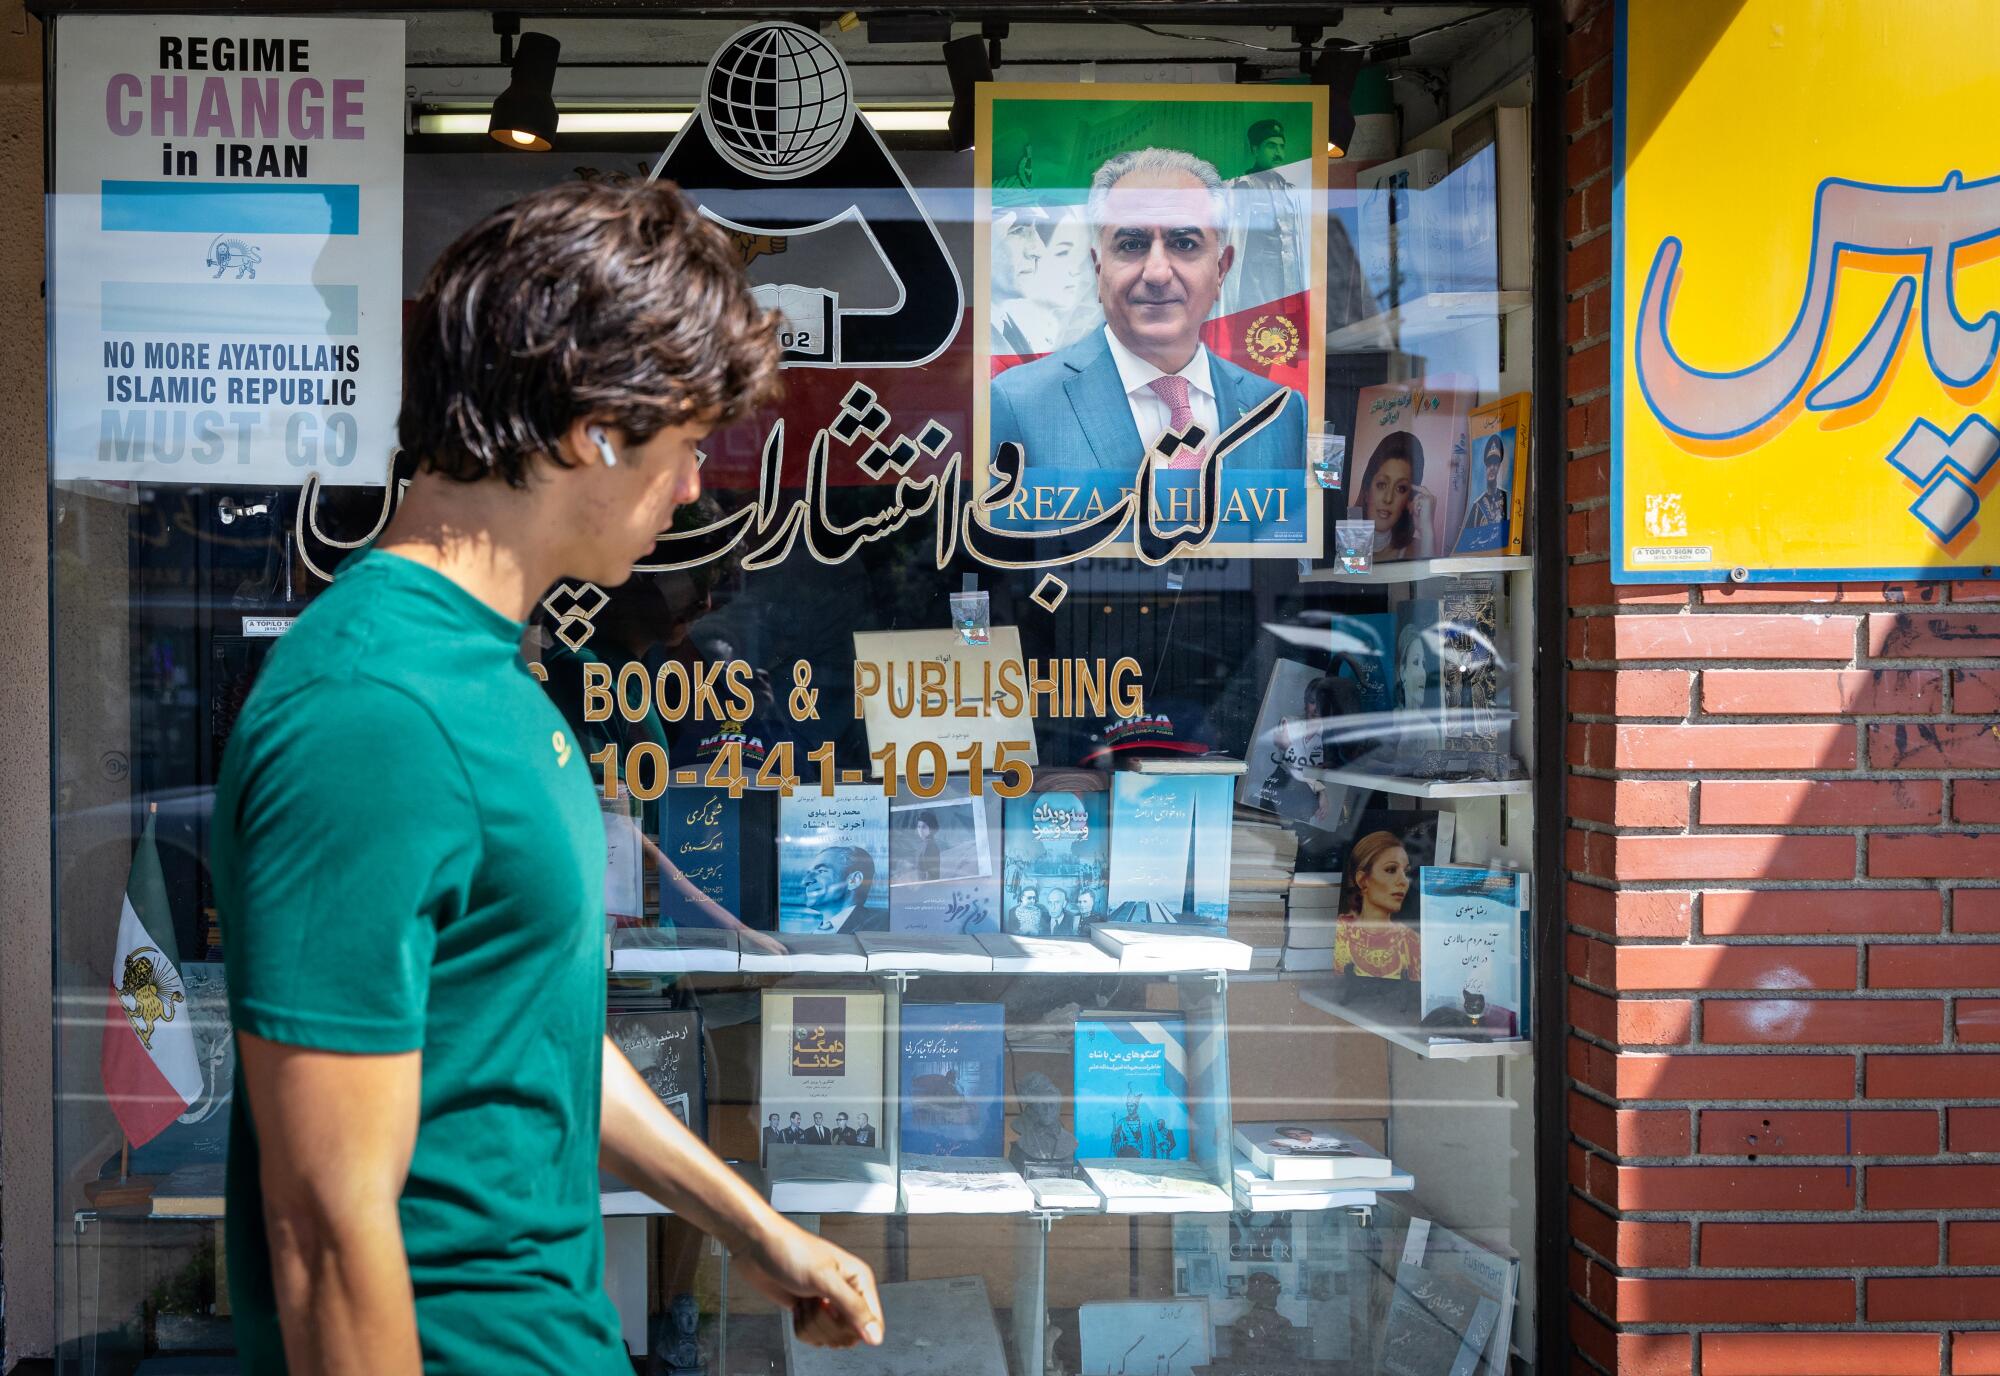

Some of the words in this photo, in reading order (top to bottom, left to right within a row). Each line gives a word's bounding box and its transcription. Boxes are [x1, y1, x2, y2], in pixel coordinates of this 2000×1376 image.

[159, 36, 310, 73] REGIME
[105, 73, 366, 140] CHANGE
[162, 143, 198, 176] in
[215, 144, 308, 178] IRAN
[103, 341, 135, 369] NO
[144, 342, 210, 371] MORE
[218, 343, 360, 372] AYATOLLAHS
[107, 375, 216, 404] ISLAMIC
[228, 377, 357, 406] REPUBLIC
[98, 409, 261, 466] MUST
[285, 411, 358, 467] GO
[1007, 486, 1105, 521] REZA
[1118, 487, 1288, 522] HAVI
[583, 659, 754, 723] BOOKS
[787, 659, 821, 722] &
[853, 656, 1144, 720] PUBLISHING
[589, 740, 1034, 801] 10-441-1015
[829, 808, 841, 818] رضا
[838, 819, 865, 831] آخرین
[654, 1025, 689, 1047] اردشیر
[793, 1039, 845, 1053] دامگه
[809, 1025, 826, 1041] در
[792, 1054, 844, 1068] حادثه
[1108, 1052, 1121, 1063] من
[1122, 1049, 1162, 1062] گفتگوهای
